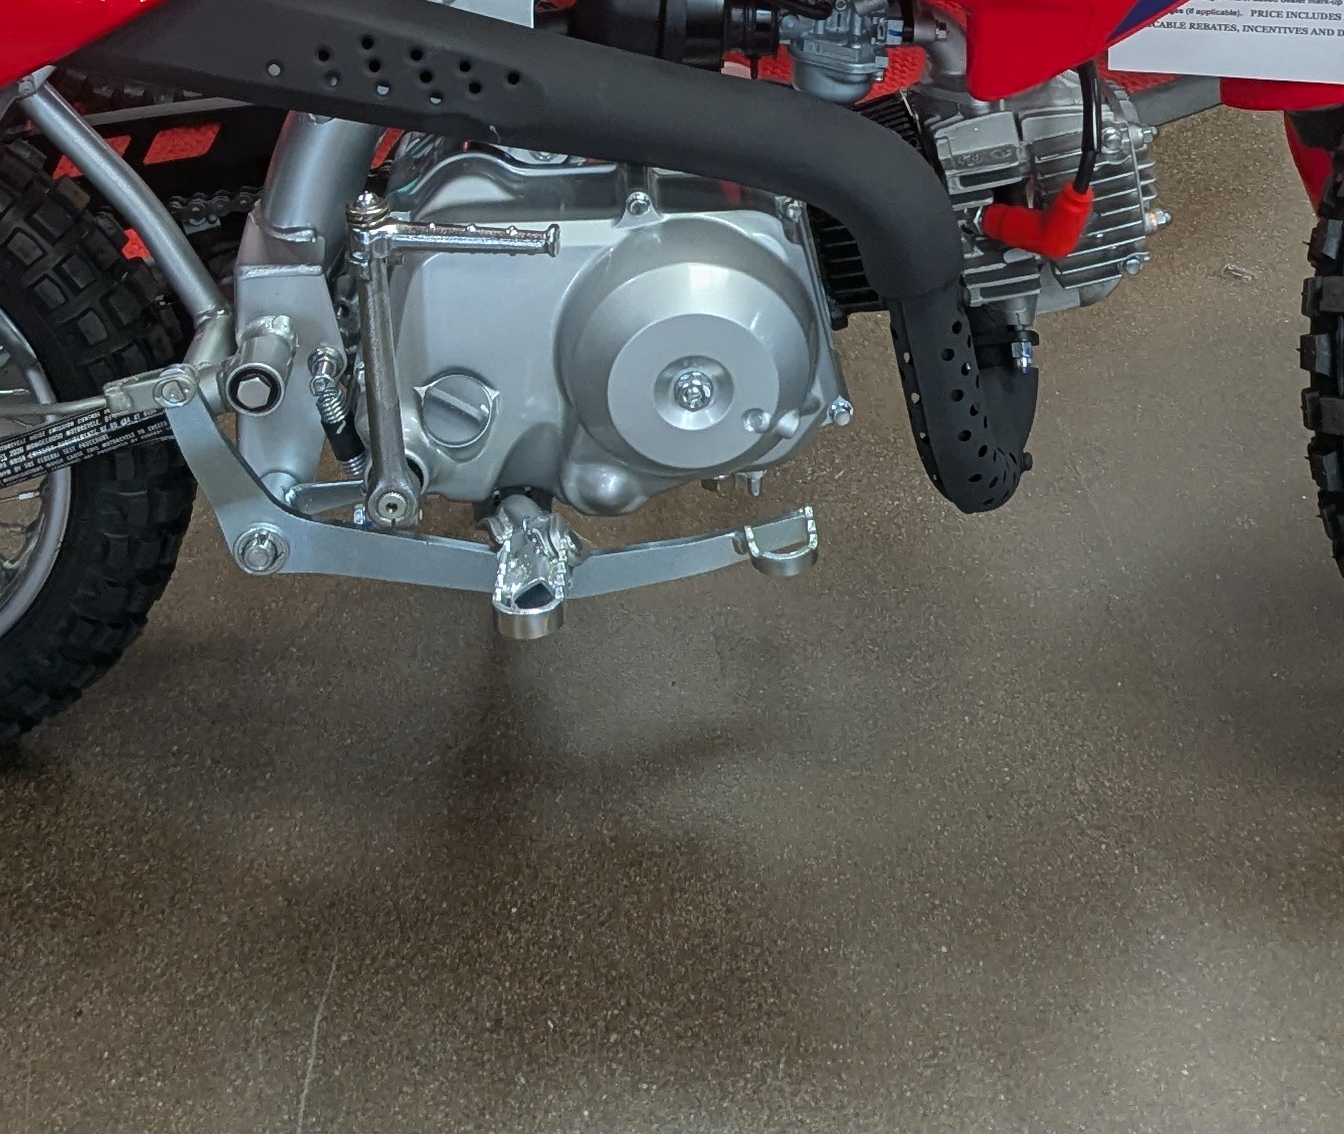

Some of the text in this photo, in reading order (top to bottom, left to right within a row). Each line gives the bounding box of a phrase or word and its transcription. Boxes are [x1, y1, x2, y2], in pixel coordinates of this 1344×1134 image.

[1185, 7, 1195, 15] (if
[1196, 8, 1243, 17] applicable).
[1250, 9, 1283, 19] PRICE
[1286, 10, 1341, 21] INCLUDES
[1189, 22, 1240, 33] REBATES,
[1242, 24, 1308, 35] INCENTIVES
[1310, 27, 1335, 36] AND
